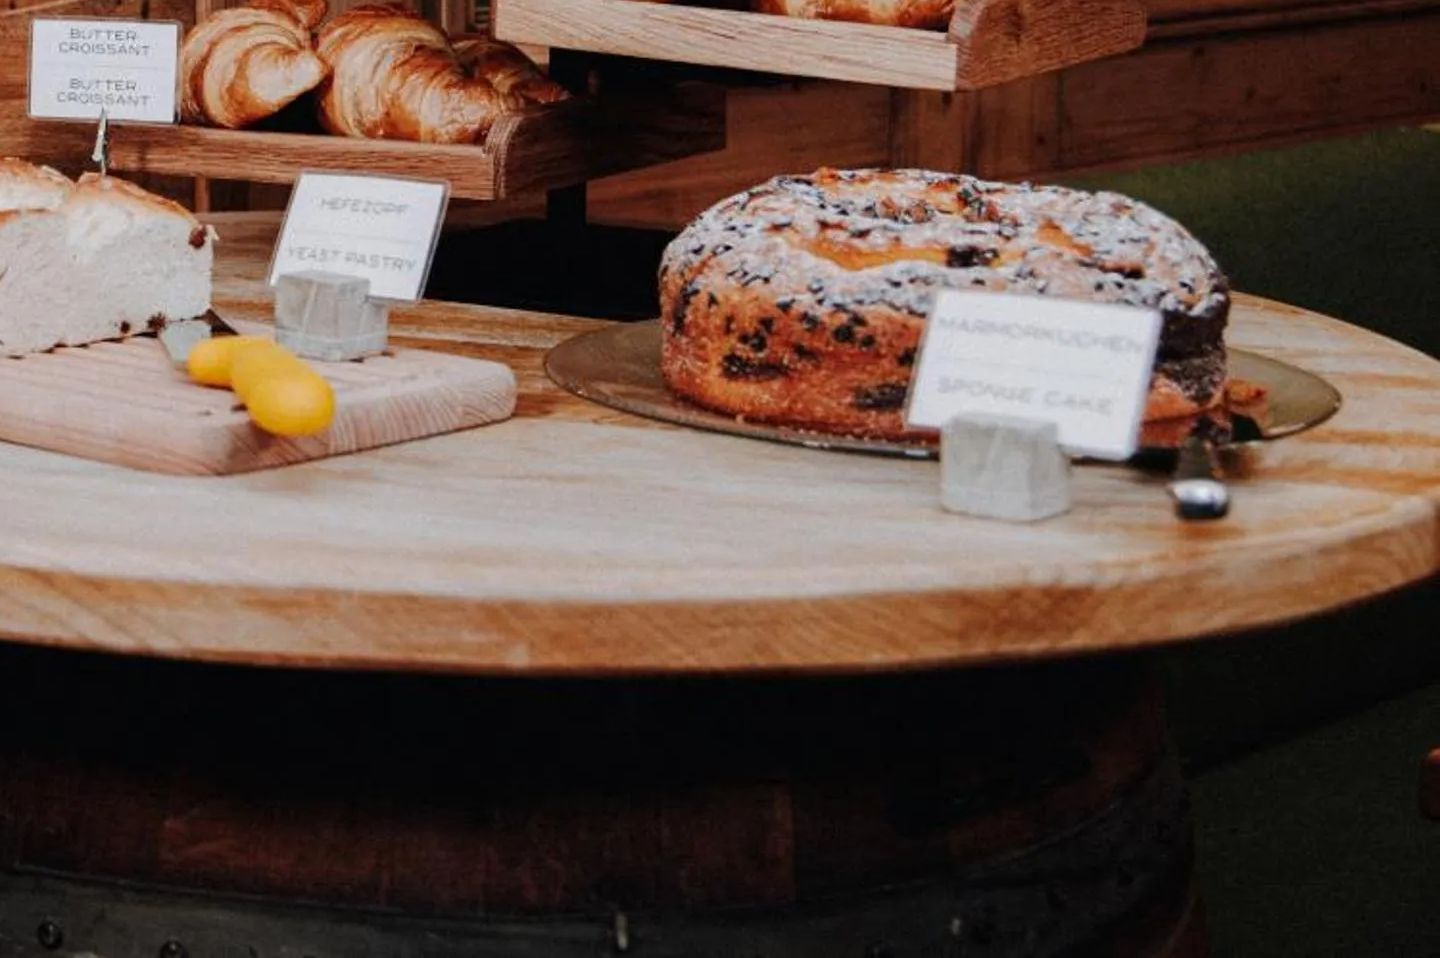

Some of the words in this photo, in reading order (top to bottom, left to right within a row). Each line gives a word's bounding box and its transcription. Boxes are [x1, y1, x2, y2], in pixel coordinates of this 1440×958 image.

[69, 28, 137, 41] BUTTER
[58, 42, 150, 56] CROISSANT
[69, 78, 137, 91] BUTTER
[56, 92, 151, 106] CROISSANT
[320, 197, 411, 215] HEFEZOPF
[286, 246, 342, 262] YEAST
[345, 251, 417, 271] PASTRY
[937, 376, 1034, 404] SPONGE
[1043, 390, 1114, 416] CAKE
